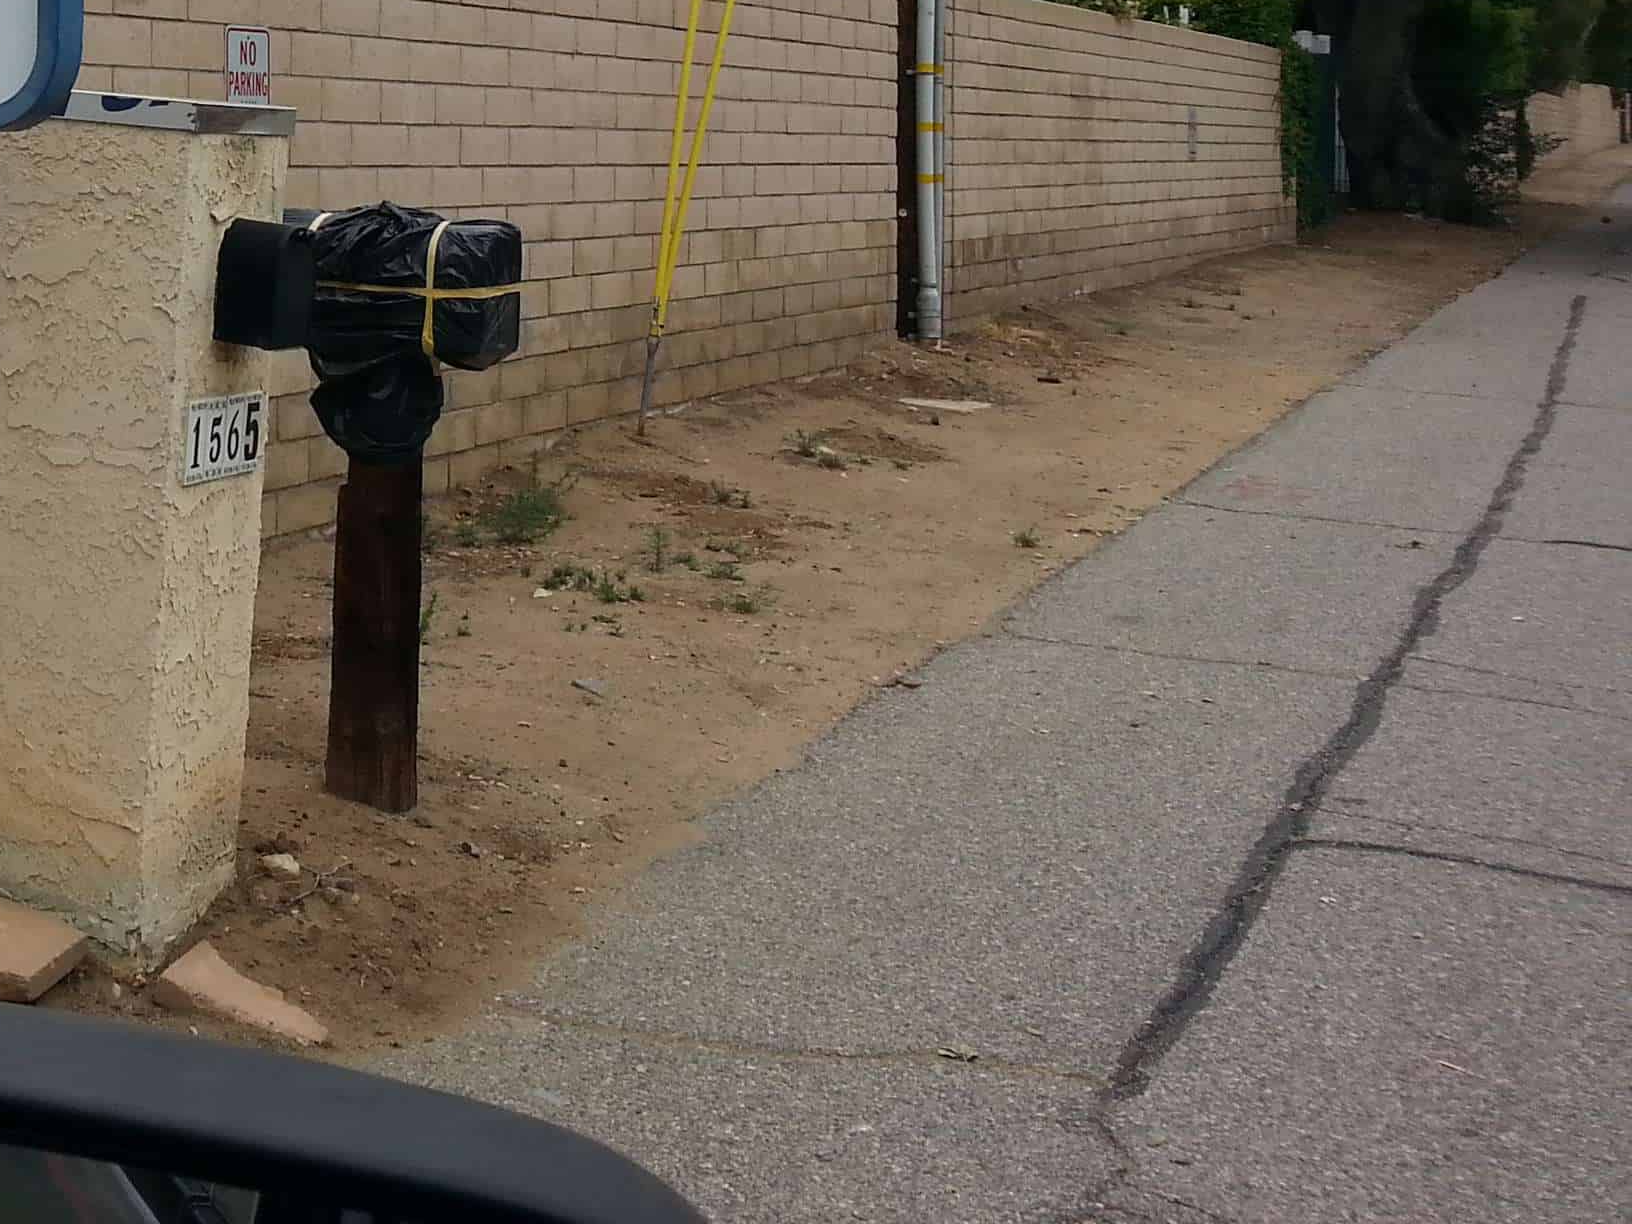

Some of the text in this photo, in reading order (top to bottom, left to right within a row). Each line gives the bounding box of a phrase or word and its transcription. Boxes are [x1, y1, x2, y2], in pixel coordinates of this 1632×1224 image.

[240, 40, 257, 66] NO
[229, 71, 268, 97] PARKING
[190, 401, 261, 469] 1565
